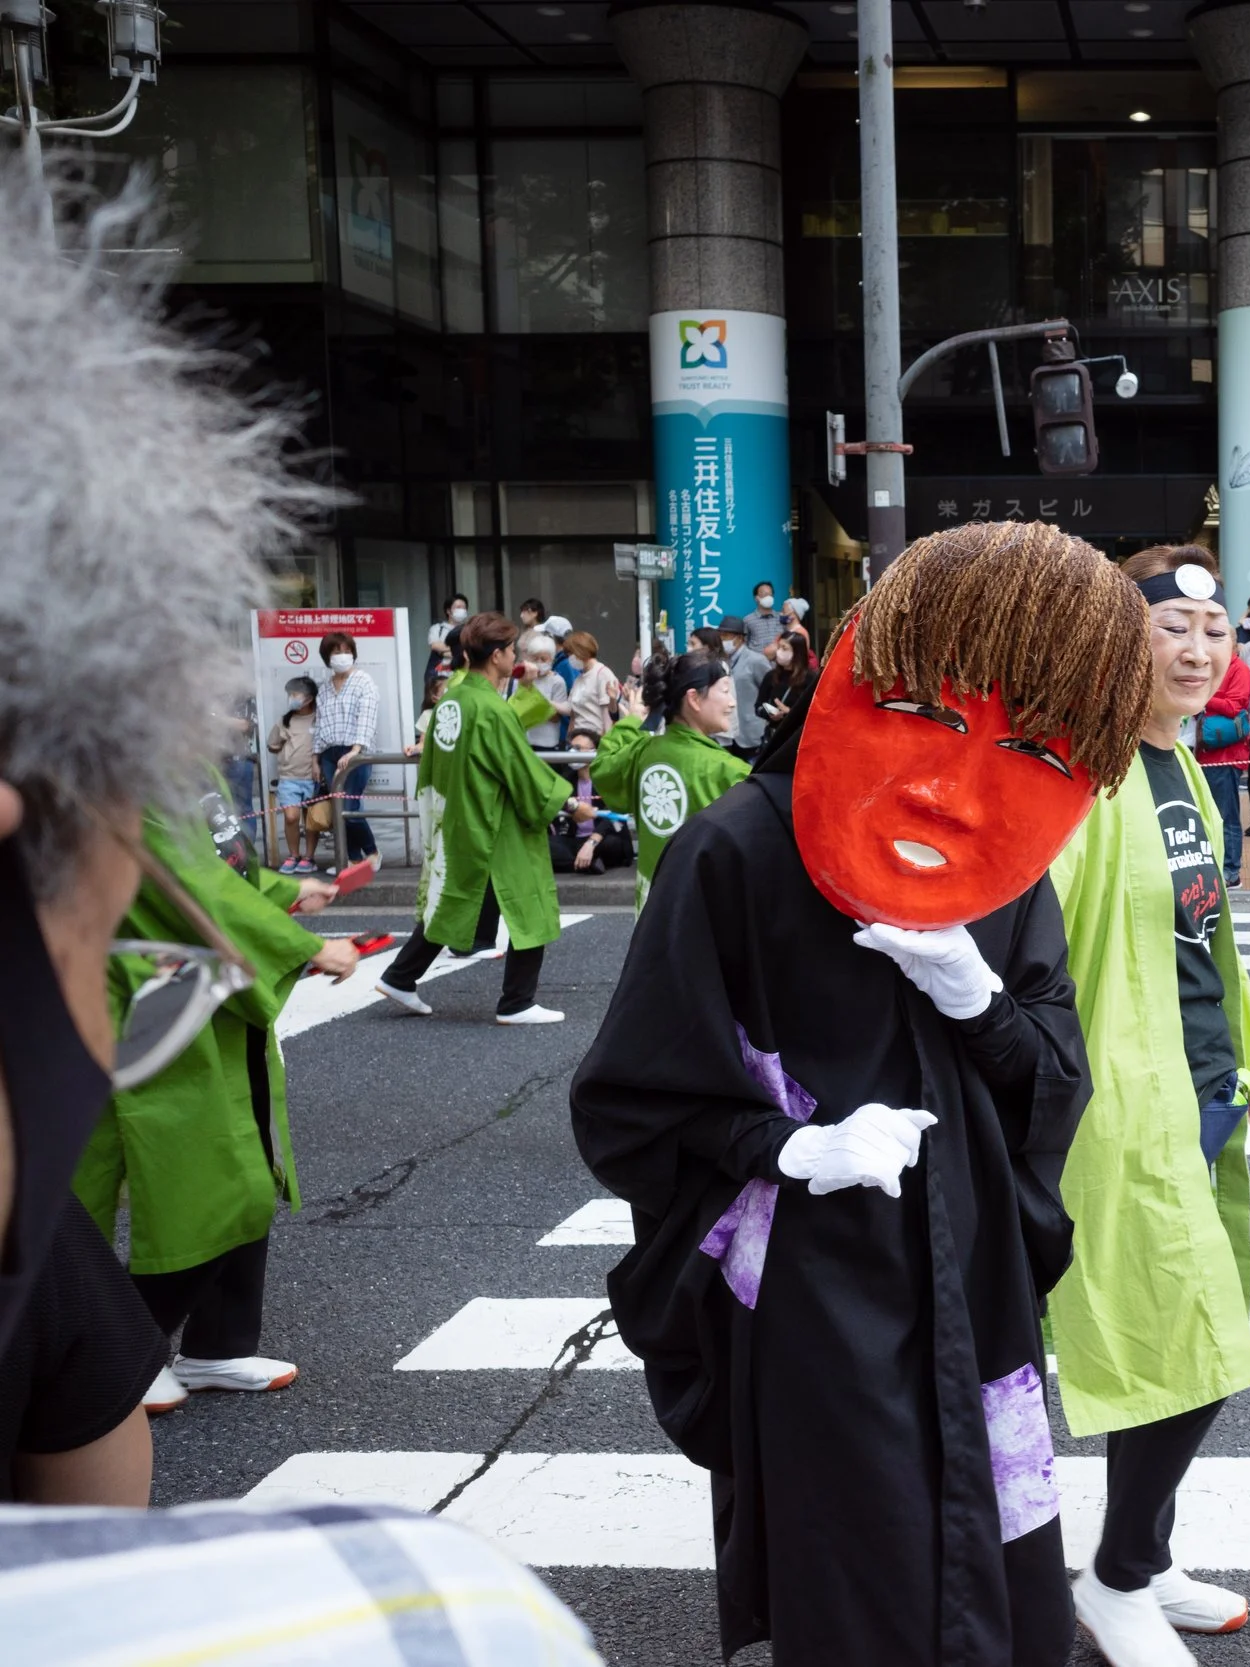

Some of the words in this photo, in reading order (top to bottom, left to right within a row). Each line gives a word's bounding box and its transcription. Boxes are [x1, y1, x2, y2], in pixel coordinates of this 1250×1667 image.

[1112, 278, 1181, 303] AXIS
[937, 499, 1093, 518] 栄ガスビル
